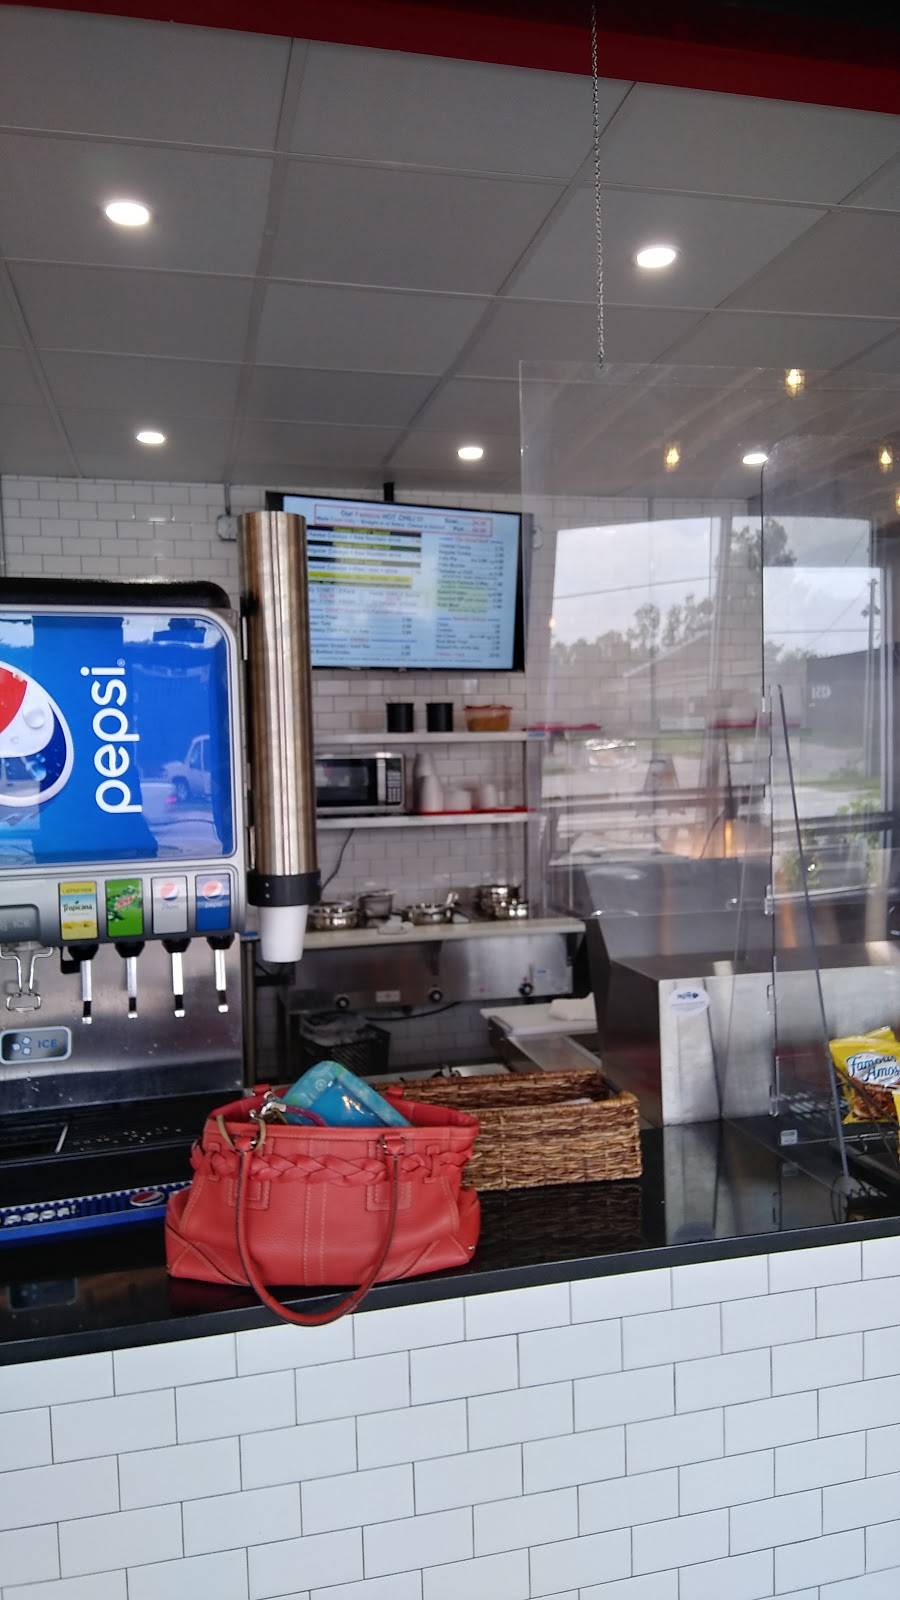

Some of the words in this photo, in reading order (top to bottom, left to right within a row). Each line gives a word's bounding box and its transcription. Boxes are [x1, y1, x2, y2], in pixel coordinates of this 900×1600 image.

[81, 666, 142, 813] pepsi
[63, 904, 93, 912] Tropicana
[37, 1038, 59, 1049] ICE
[846, 1055, 896, 1077] Famous
[863, 1065, 900, 1081] Amos
